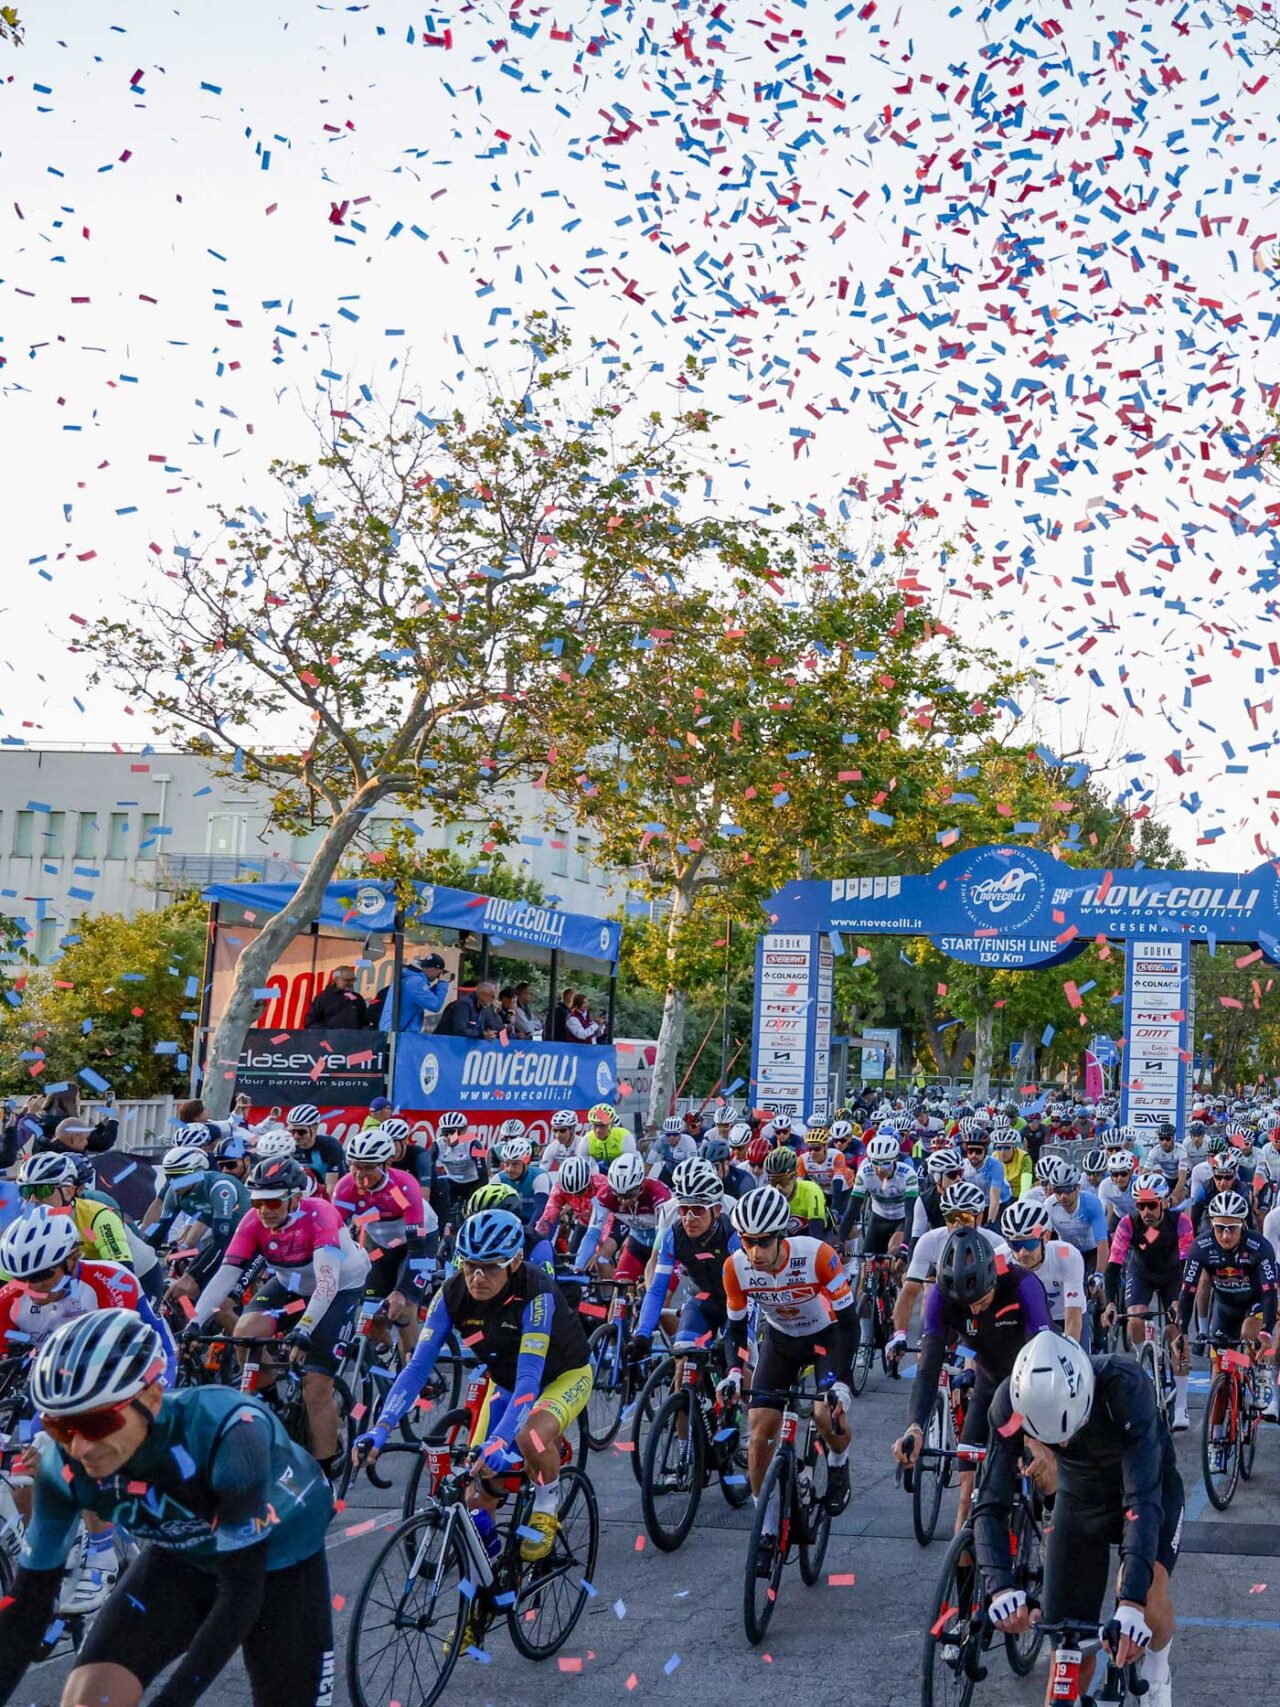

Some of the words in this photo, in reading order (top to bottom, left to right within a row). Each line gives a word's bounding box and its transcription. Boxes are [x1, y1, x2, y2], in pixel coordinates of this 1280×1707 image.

[1080, 907, 1252, 918] www.novecolli.it
[830, 918, 922, 928] www.novecolli.it
[1110, 922, 1208, 934] CESENAICO
[941, 938, 1026, 952] START/FINISH
[1030, 940, 1057, 953] LINE
[980, 953, 1000, 962] 130
[1003, 953, 1024, 963] Km
[461, 1050, 578, 1086] NOVECOLLI
[269, 1078, 312, 1086] partner
[460, 1088, 572, 1100] www.ovecolli.it
[1185, 1260, 1199, 1282] BOSS
[1261, 1259, 1275, 1280] BOSS
[749, 1277, 767, 1286] AG
